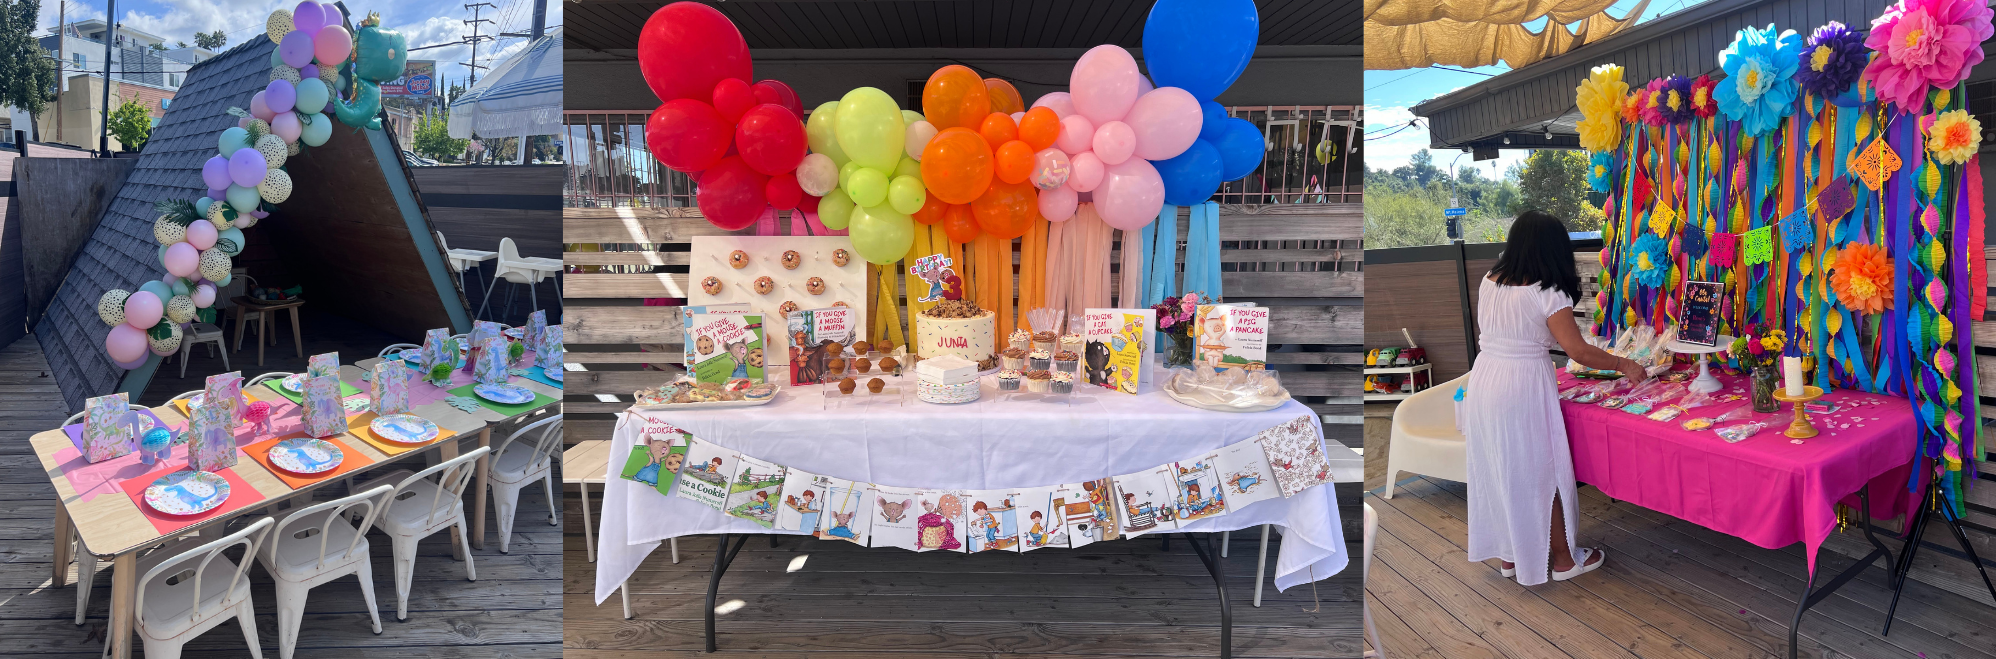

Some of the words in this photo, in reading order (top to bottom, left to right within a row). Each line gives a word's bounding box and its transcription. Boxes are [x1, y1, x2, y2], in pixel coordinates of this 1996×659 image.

[911, 259, 952, 274] BIRTHDAY!
[917, 254, 942, 266] HAPPY
[943, 275, 962, 300] 3
[696, 328, 703, 336] IF
[703, 322, 714, 333] YOU
[715, 317, 729, 328] GIVE
[718, 322, 738, 336] MOUSE
[722, 328, 745, 342] COOKIE
[938, 337, 968, 348] JUNIA
[648, 426, 674, 434] COOKIE
[697, 483, 725, 499] Cookie
